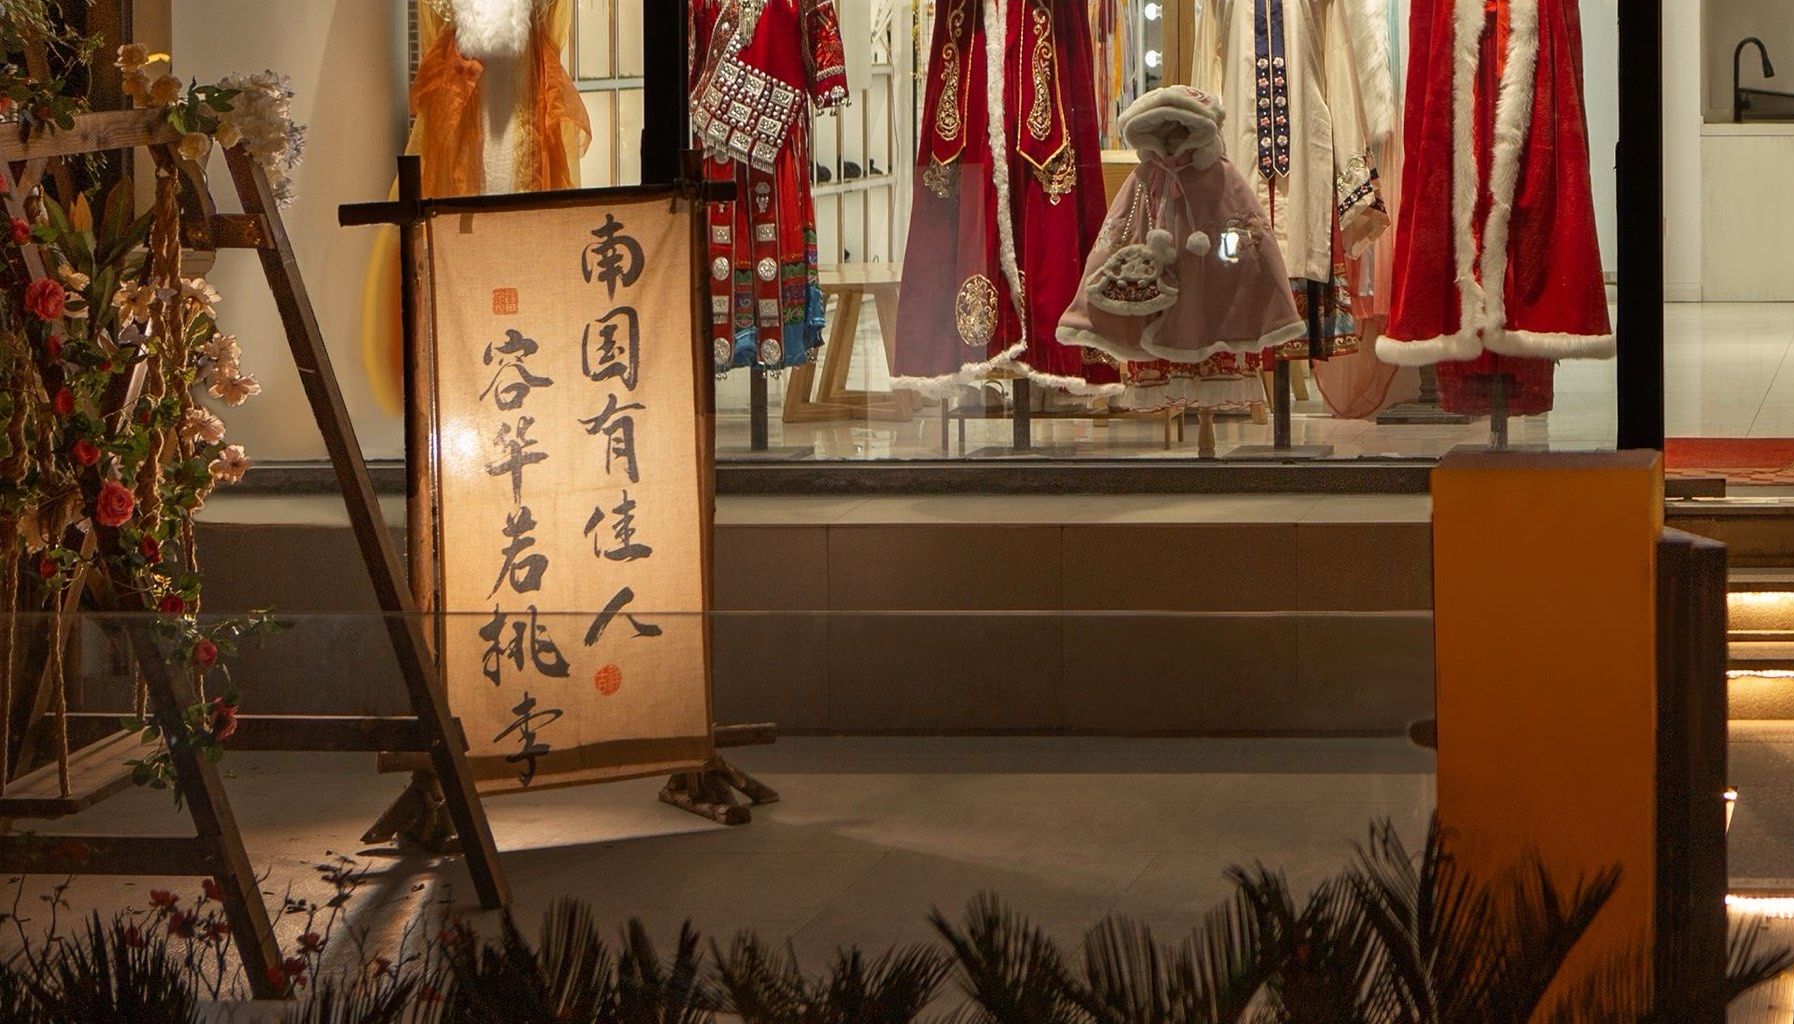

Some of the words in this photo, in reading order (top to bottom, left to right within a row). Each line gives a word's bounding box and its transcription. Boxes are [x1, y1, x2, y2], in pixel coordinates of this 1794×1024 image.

[578, 213, 663, 647] 南国有佳人
